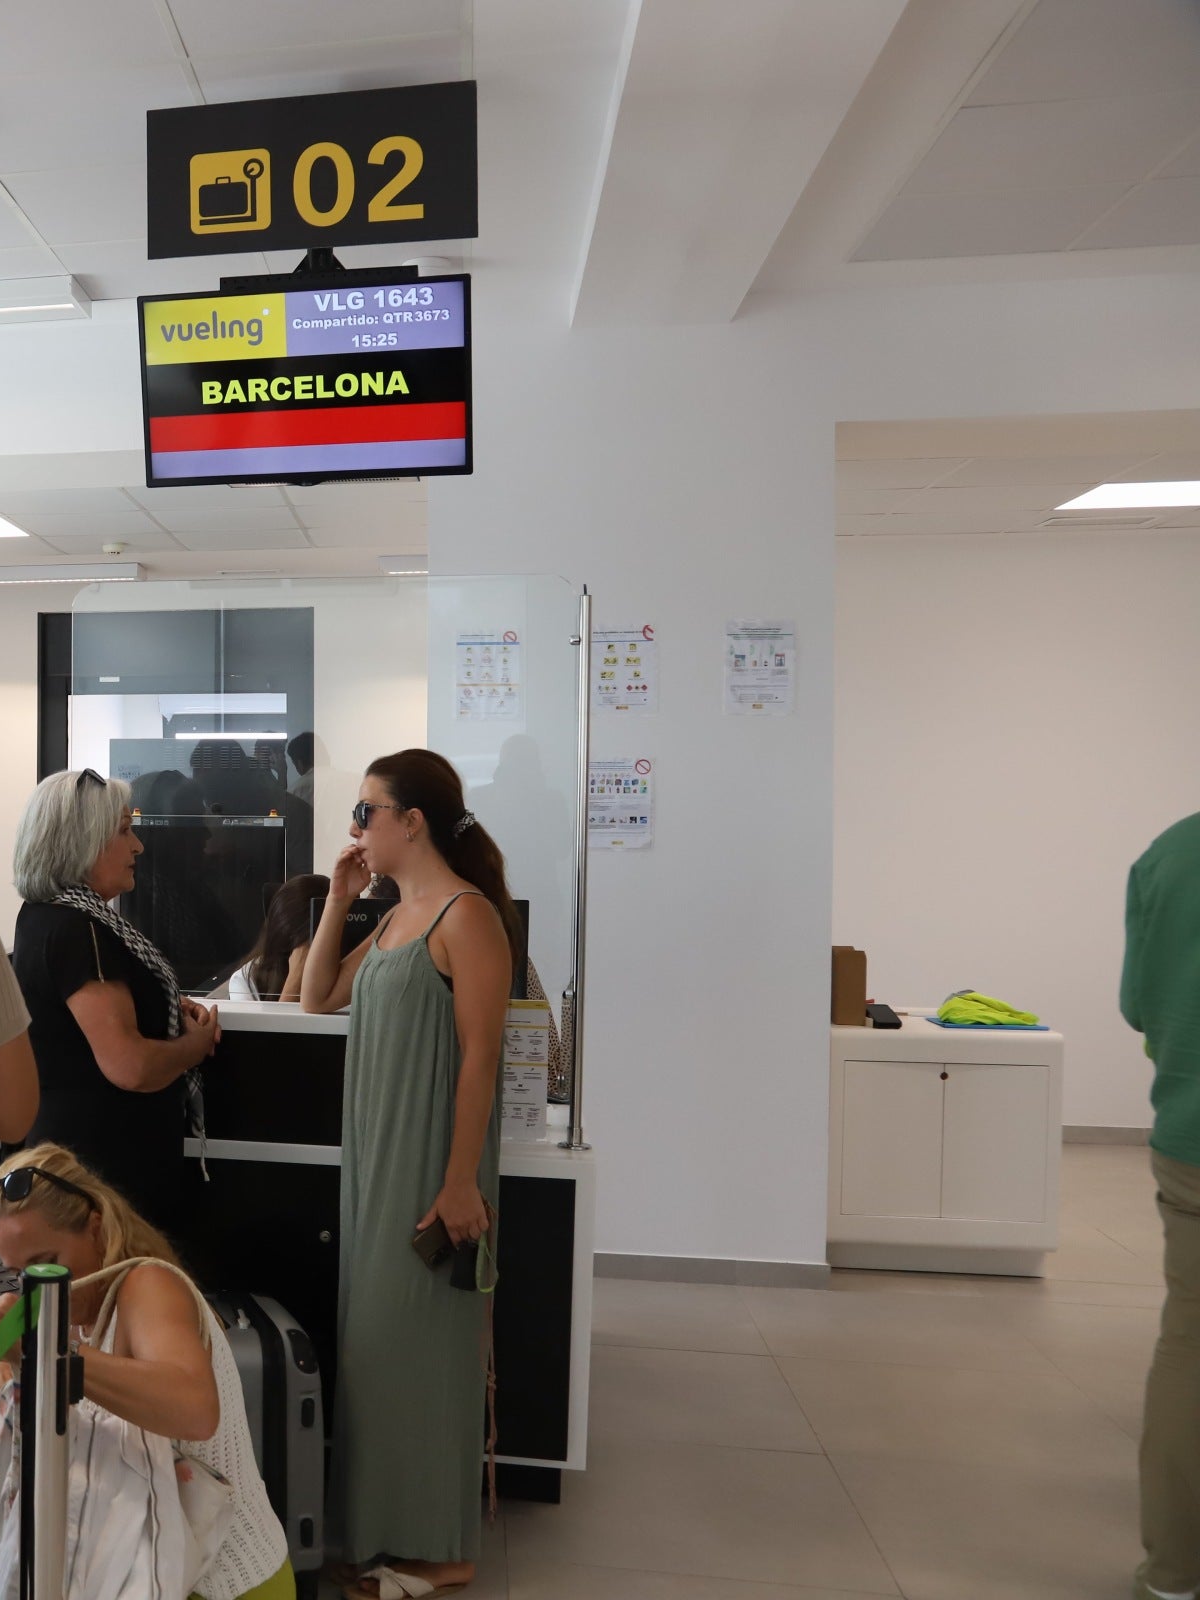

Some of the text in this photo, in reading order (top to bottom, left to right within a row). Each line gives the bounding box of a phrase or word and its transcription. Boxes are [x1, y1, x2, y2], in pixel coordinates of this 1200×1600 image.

[293, 136, 425, 227] 02
[313, 287, 434, 312] VLG 1643
[161, 310, 263, 346] vueling
[292, 309, 450, 330] Compartido: QTR3673
[352, 333, 398, 348] 15:25
[201, 370, 410, 405] BARCELONA
